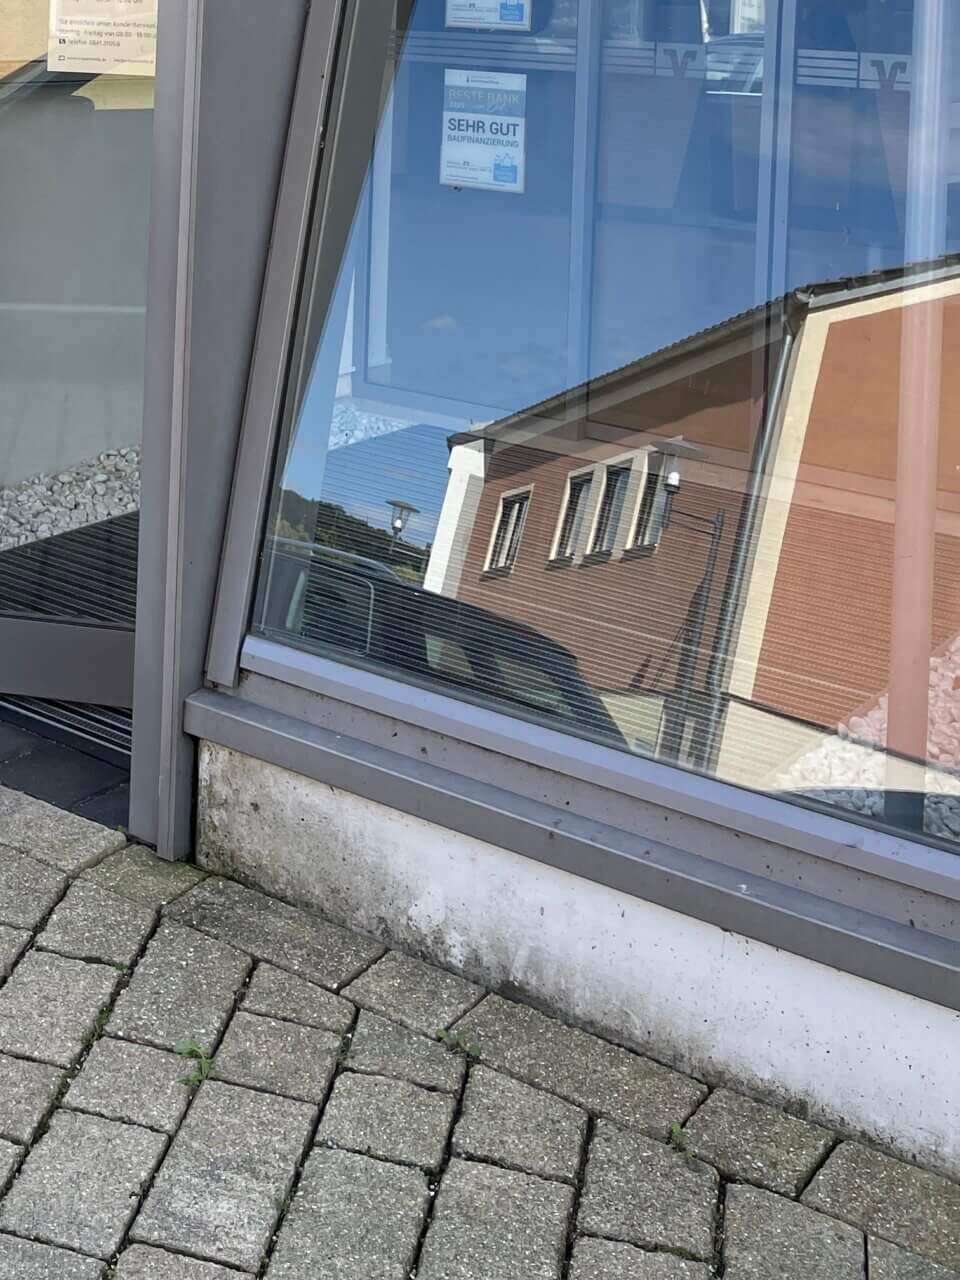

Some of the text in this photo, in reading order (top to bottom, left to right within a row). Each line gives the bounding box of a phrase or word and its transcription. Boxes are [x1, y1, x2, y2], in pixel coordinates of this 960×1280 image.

[447, 118, 520, 136] SEHR GUT
[447, 134, 519, 148] BAUFINANZIERUNG
